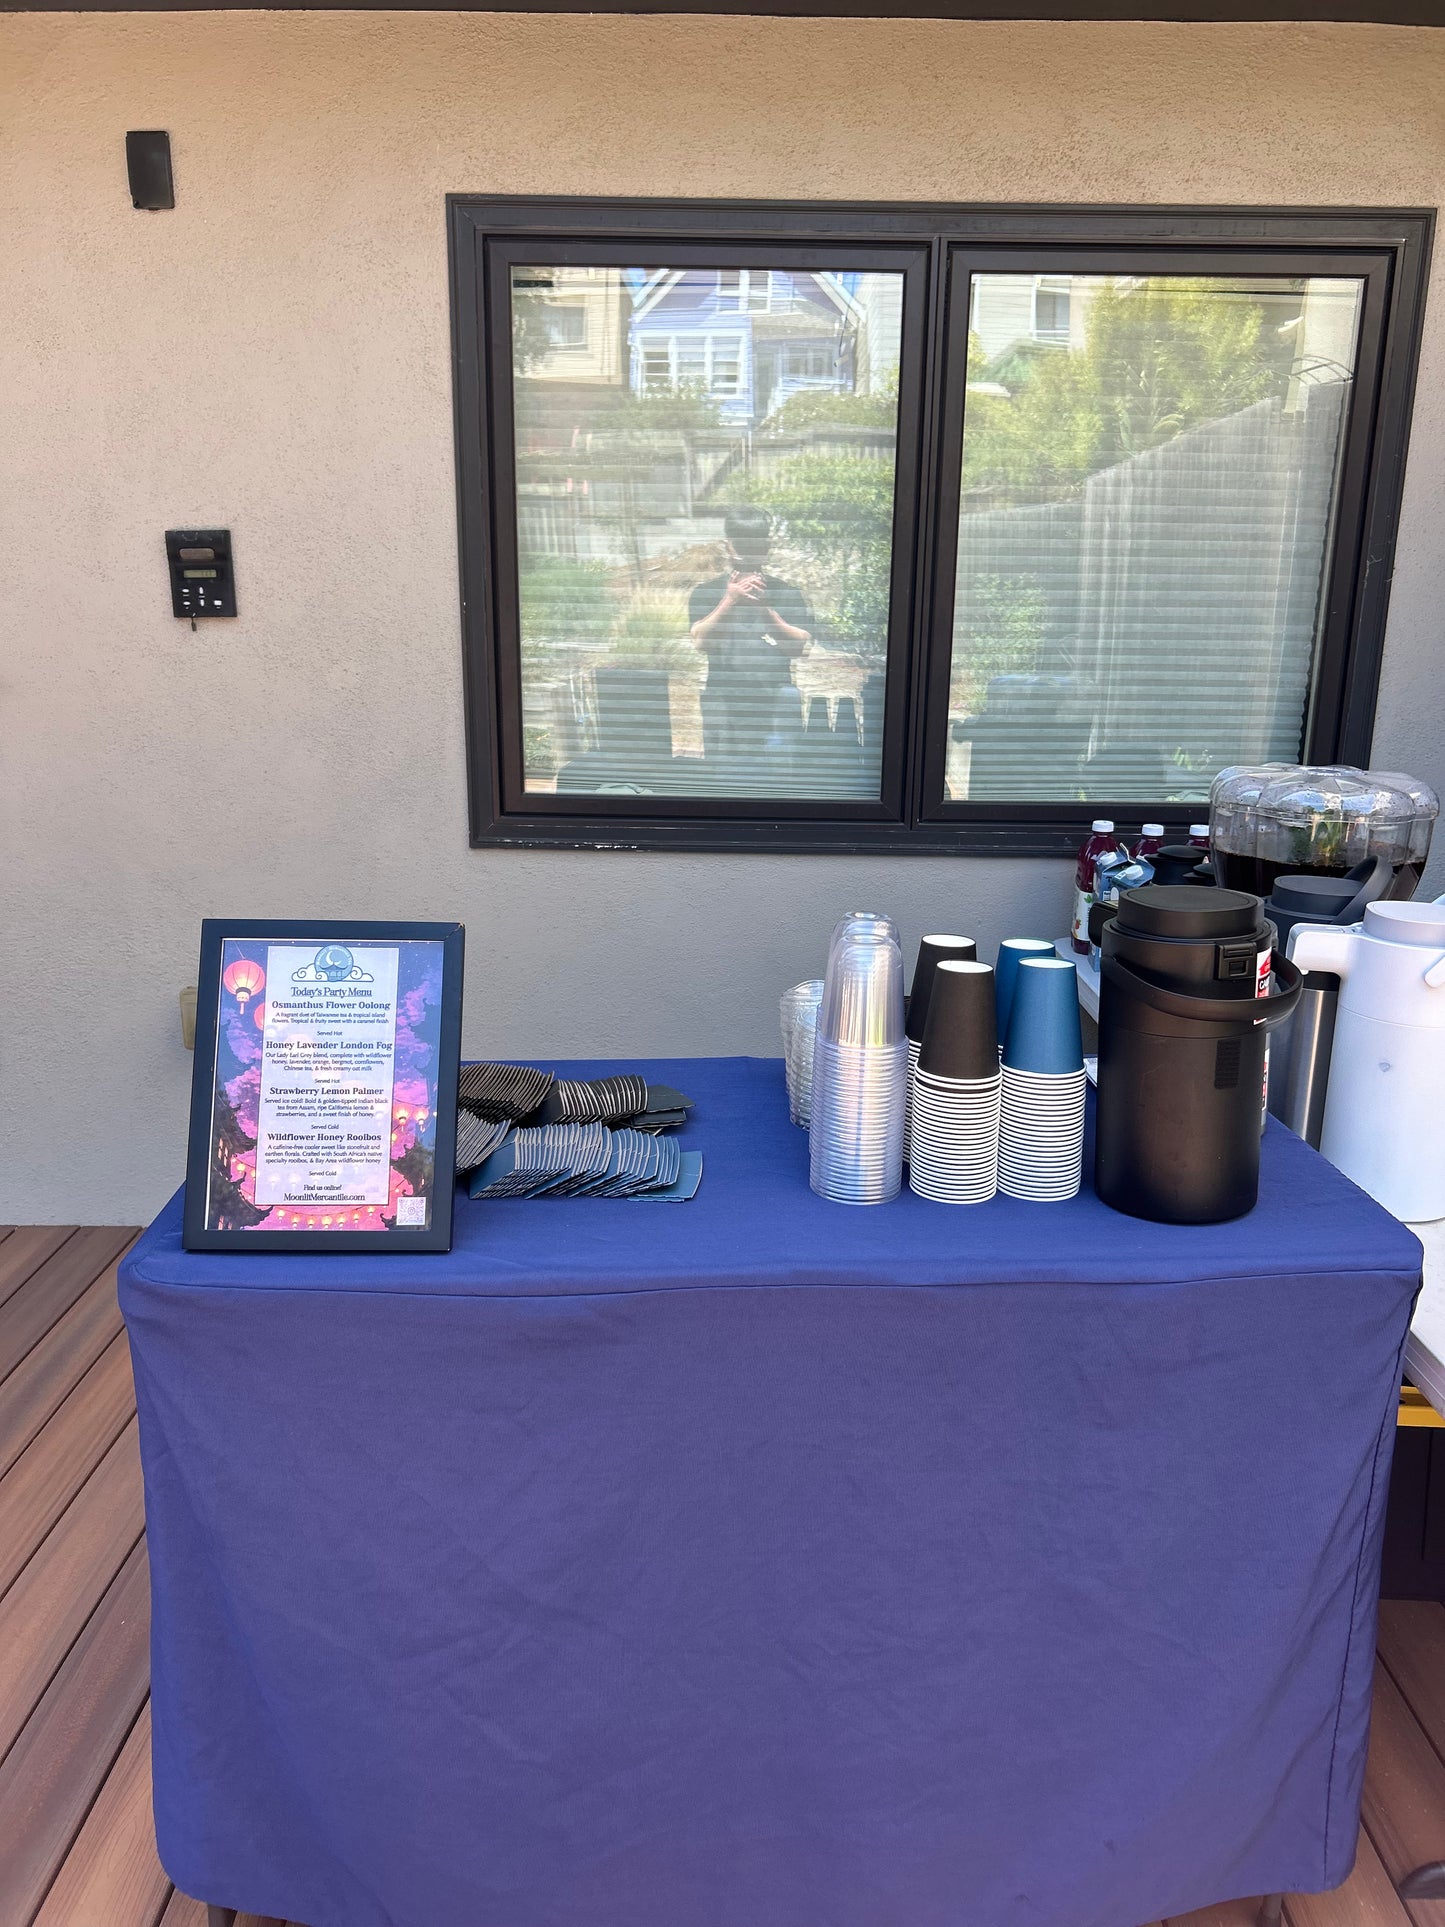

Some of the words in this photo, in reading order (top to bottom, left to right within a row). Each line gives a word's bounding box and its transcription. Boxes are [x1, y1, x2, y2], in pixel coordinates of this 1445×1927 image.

[291, 986, 322, 998] Today's
[323, 987, 347, 998] Party
[348, 987, 372, 997] Menu
[272, 1001, 325, 1009] Osmanthus
[326, 1001, 357, 1010] Flower
[358, 1001, 391, 1011] Oolong
[266, 1040, 294, 1050] Honey
[297, 1041, 339, 1049] Lavender
[339, 1041, 374, 1050] London
[376, 1041, 393, 1051] Fog
[270, 1086, 320, 1096] Strawberry
[321, 1087, 350, 1095] Lemon
[353, 1087, 384, 1095] Palmer
[268, 1133, 316, 1141] Wildflower
[317, 1133, 345, 1143] Honey
[346, 1133, 382, 1142] Rooibos
[284, 1193, 366, 1201] MoonlitMercantile.com
